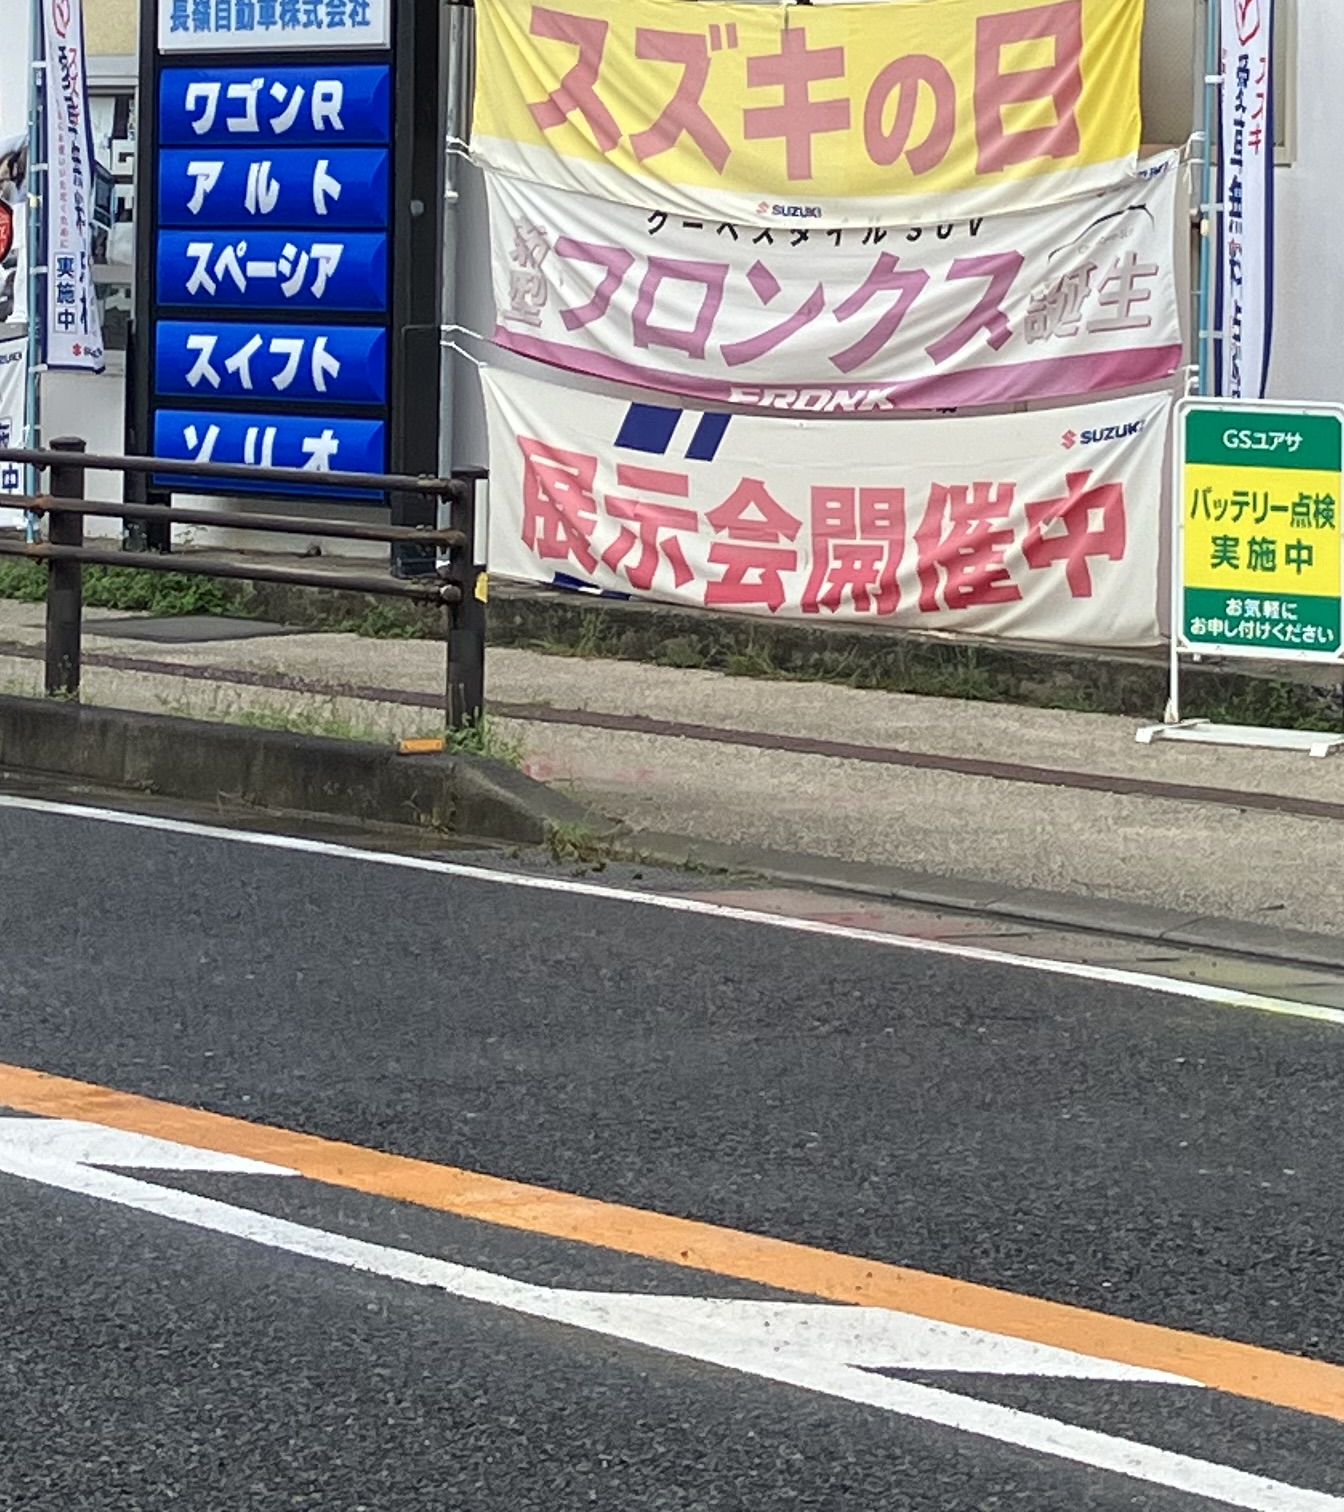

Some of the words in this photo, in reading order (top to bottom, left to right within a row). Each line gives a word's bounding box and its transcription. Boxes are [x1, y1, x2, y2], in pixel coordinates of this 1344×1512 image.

[185, 77, 345, 135] ワゴンR
[185, 158, 342, 216] アルト
[771, 203, 822, 219] SUZUKI
[56, 256, 76, 331] 実施中
[184, 239, 345, 299] スペーシア
[552, 235, 1025, 374] フロンクス
[1022, 252, 1159, 345] 誕生
[184, 333, 341, 392] スイフト
[182, 423, 340, 472] ソリオ
[1080, 420, 1145, 445] SUZUKI
[1222, 429, 1303, 452] GSユアサ
[516, 434, 1130, 616] 展示会開催中
[1190, 485, 1336, 529] バッテリー点検
[1210, 534, 1314, 575] 実施中
[1189, 618, 1335, 644] お申し付けください
[1225, 597, 1299, 620] お気軽に
